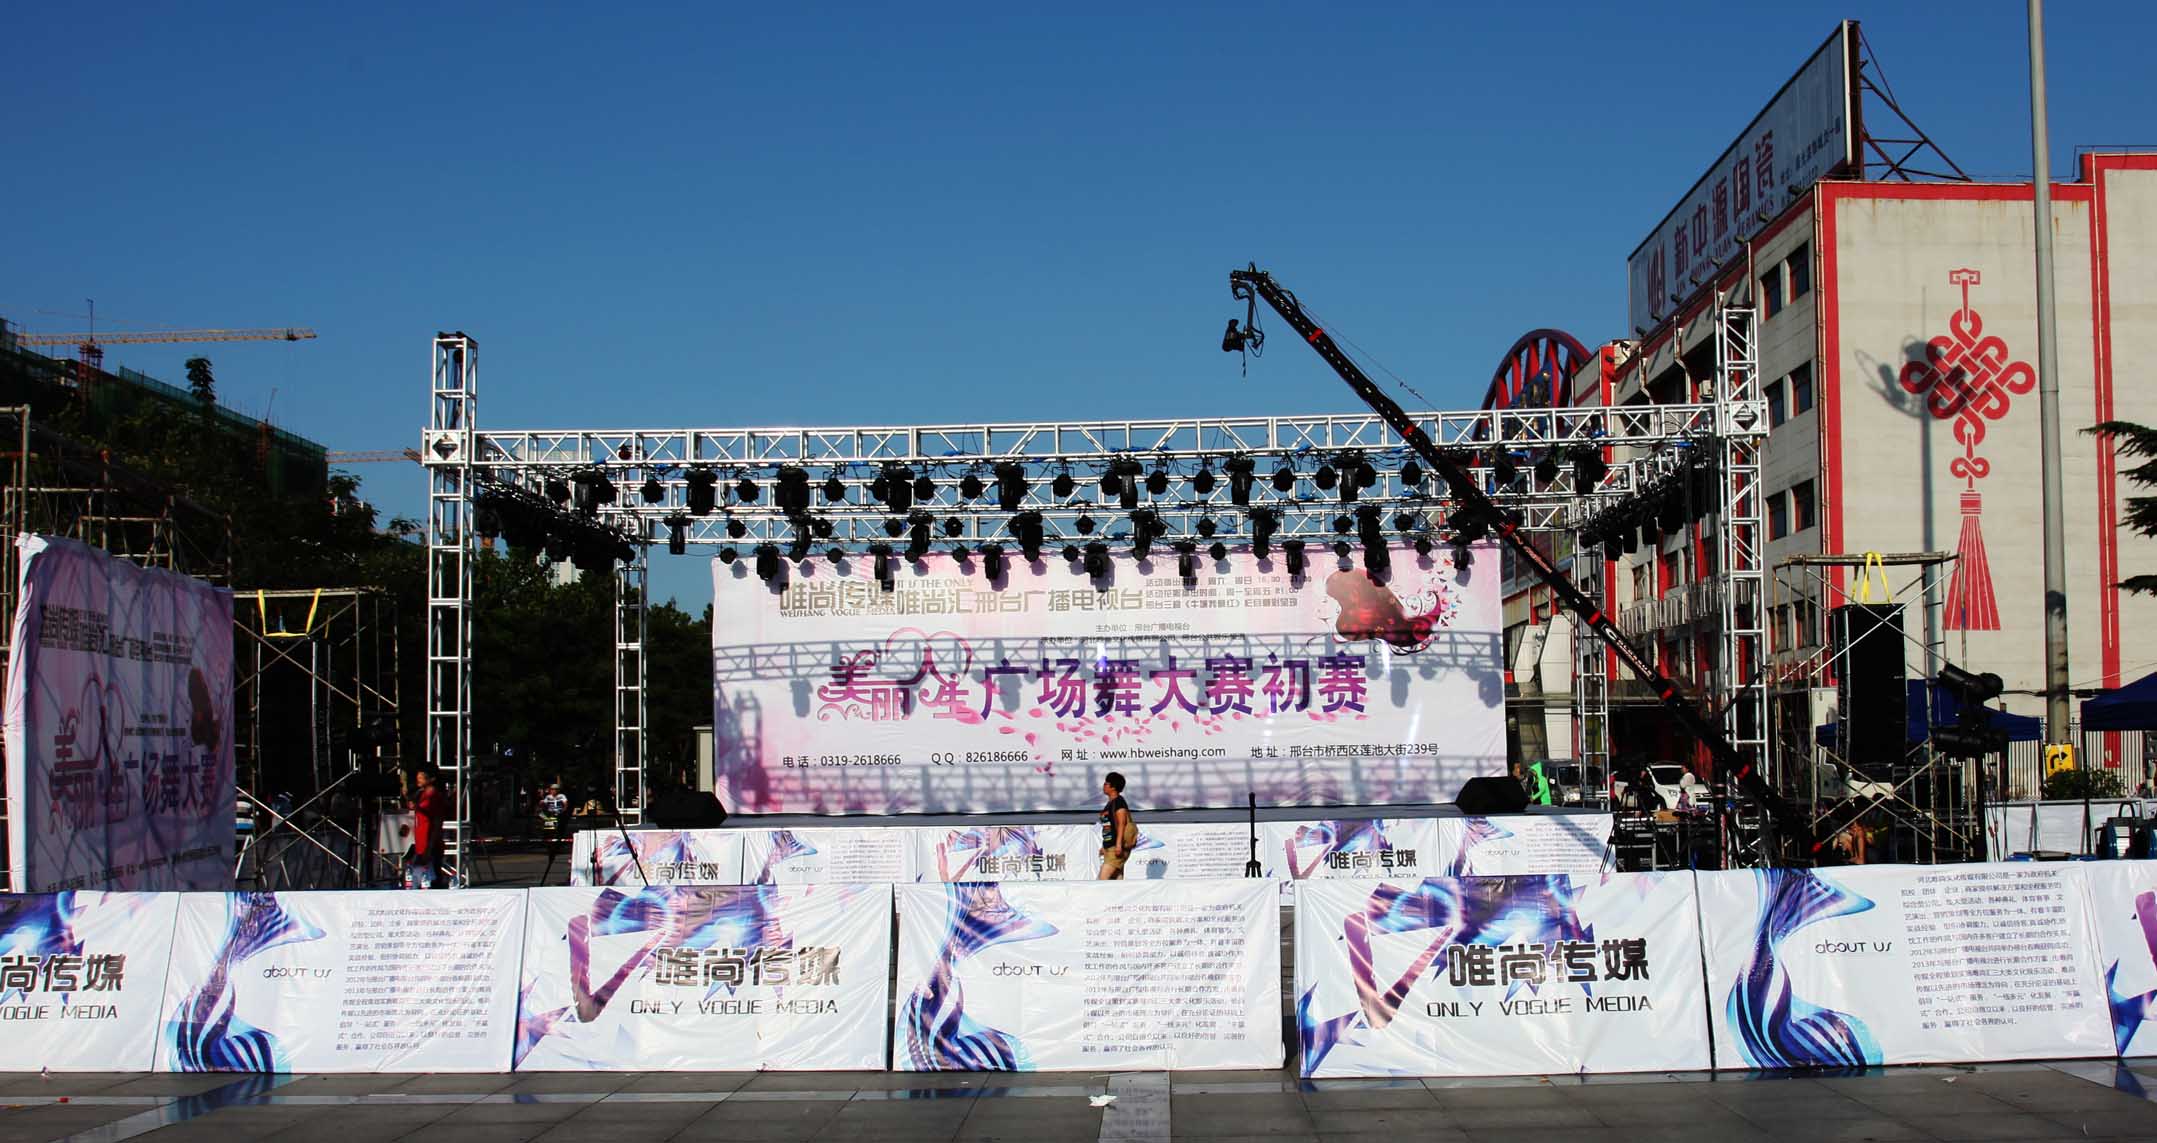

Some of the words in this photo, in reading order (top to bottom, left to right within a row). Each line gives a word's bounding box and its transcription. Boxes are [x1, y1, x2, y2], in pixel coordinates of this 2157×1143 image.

[979, 854, 1066, 875] 唯尚传媒
[1329, 849, 1417, 870] 唯尚传媒
[655, 945, 841, 987] 唯尚传媒
[1446, 937, 1651, 988] 唯尚传媒
[0, 1004, 50, 1021] OGUE
[60, 1004, 119, 1020] MEDIA
[630, 998, 684, 1015] ONLY
[698, 998, 764, 1015] VOGUE
[776, 998, 839, 1015] MEDIA
[1427, 1000, 1484, 1018] ONLY
[1498, 996, 1573, 1017] VOGUE
[1585, 994, 1654, 1014] MEDIA
